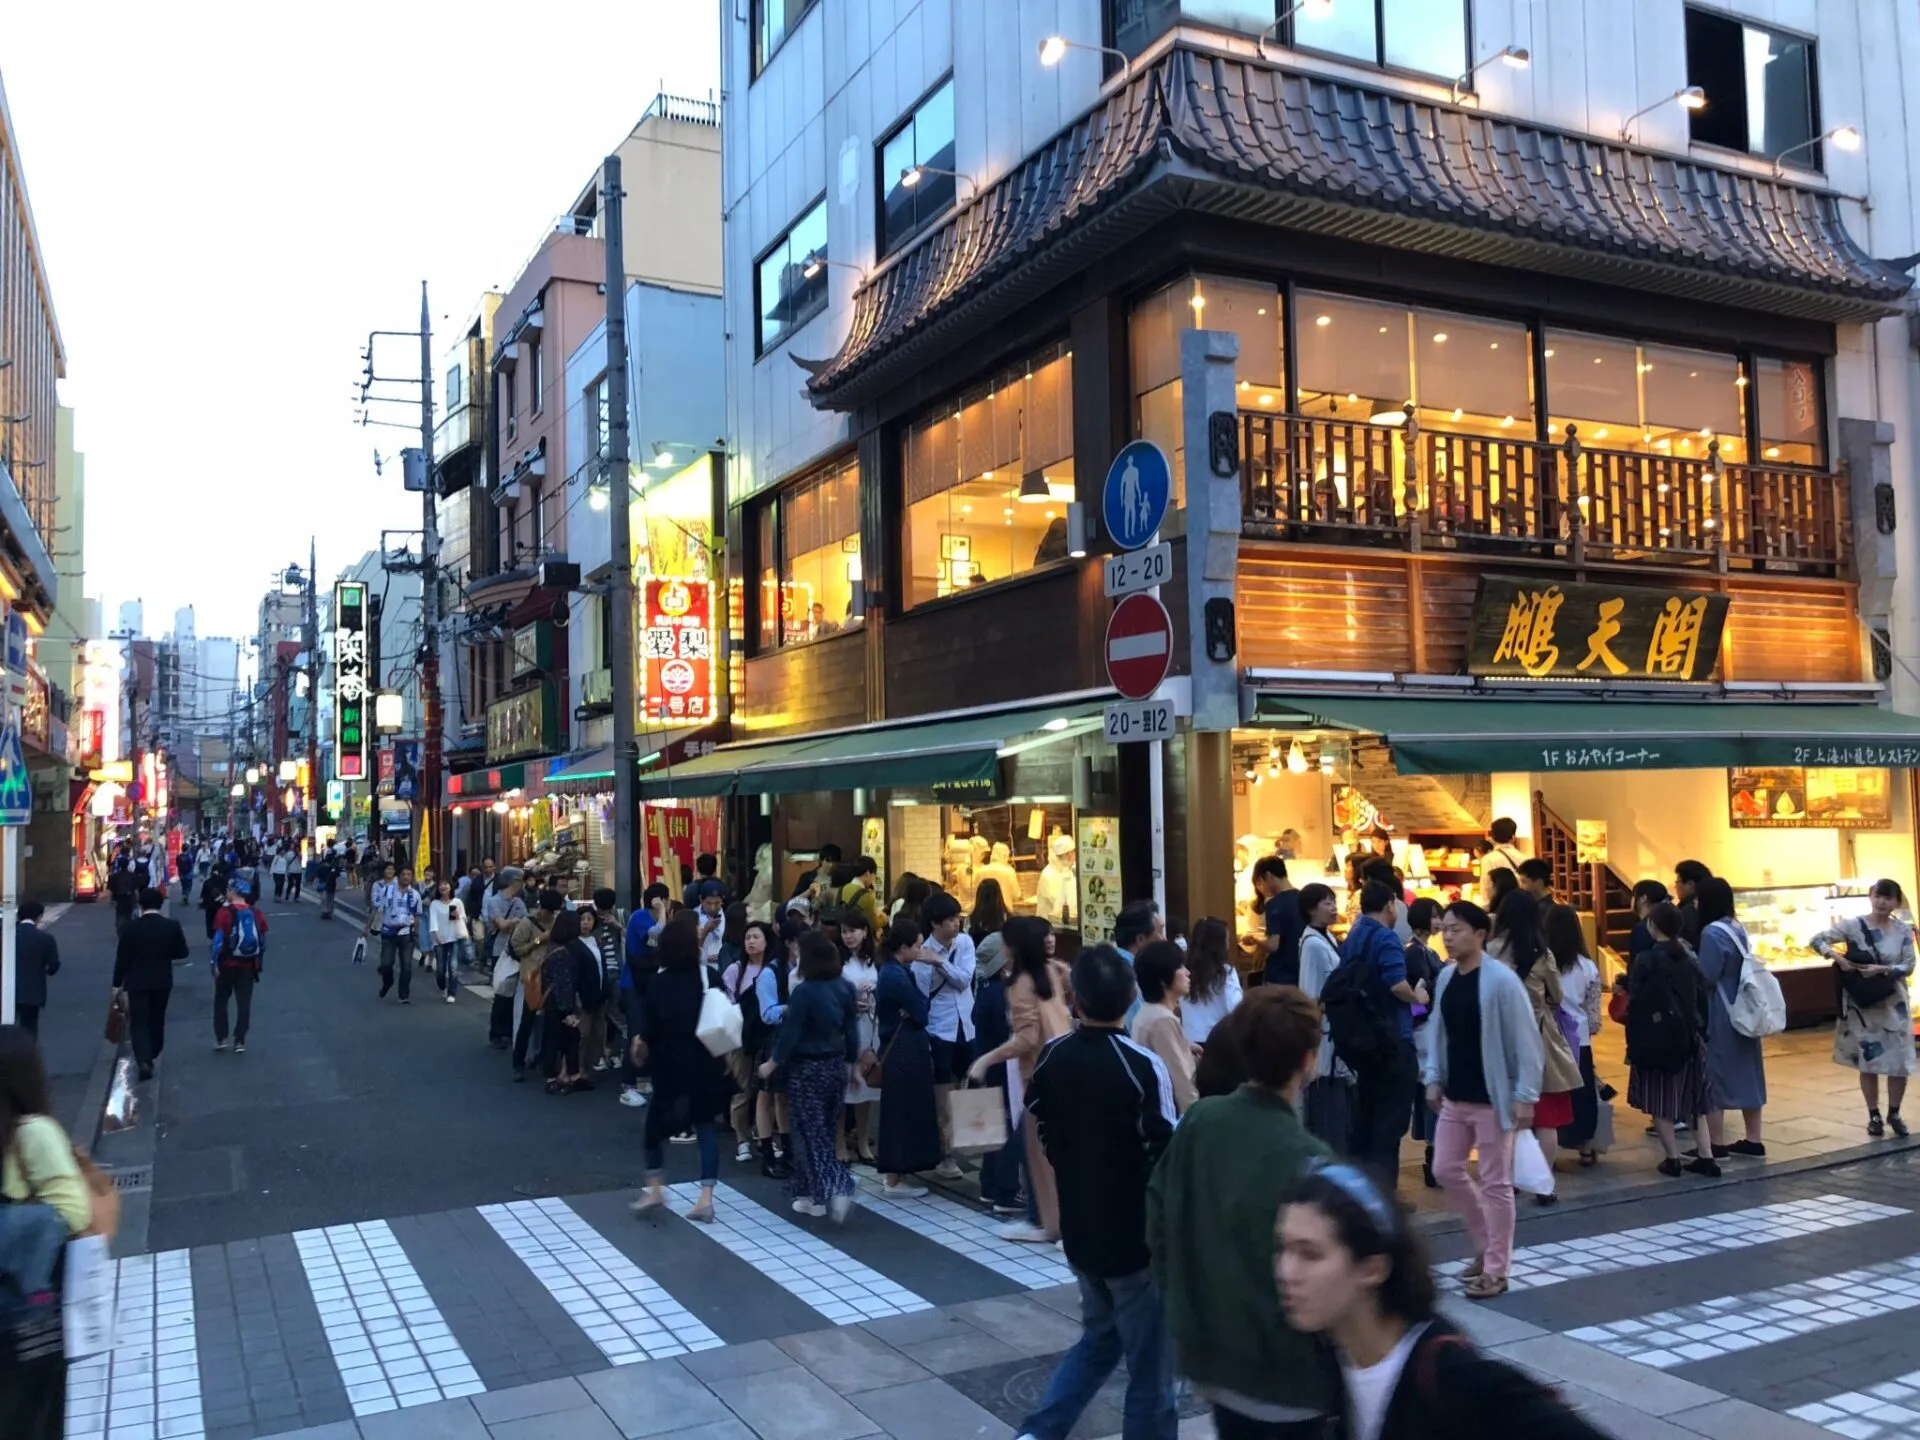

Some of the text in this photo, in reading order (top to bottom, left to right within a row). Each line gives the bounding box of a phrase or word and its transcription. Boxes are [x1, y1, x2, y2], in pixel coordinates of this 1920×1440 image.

[647, 627, 708, 659] 愛梨
[1493, 584, 1708, 681] 鵬天閣
[1542, 747, 1661, 767] 1F おみやげコーナー
[1794, 746, 1811, 763] 2F
